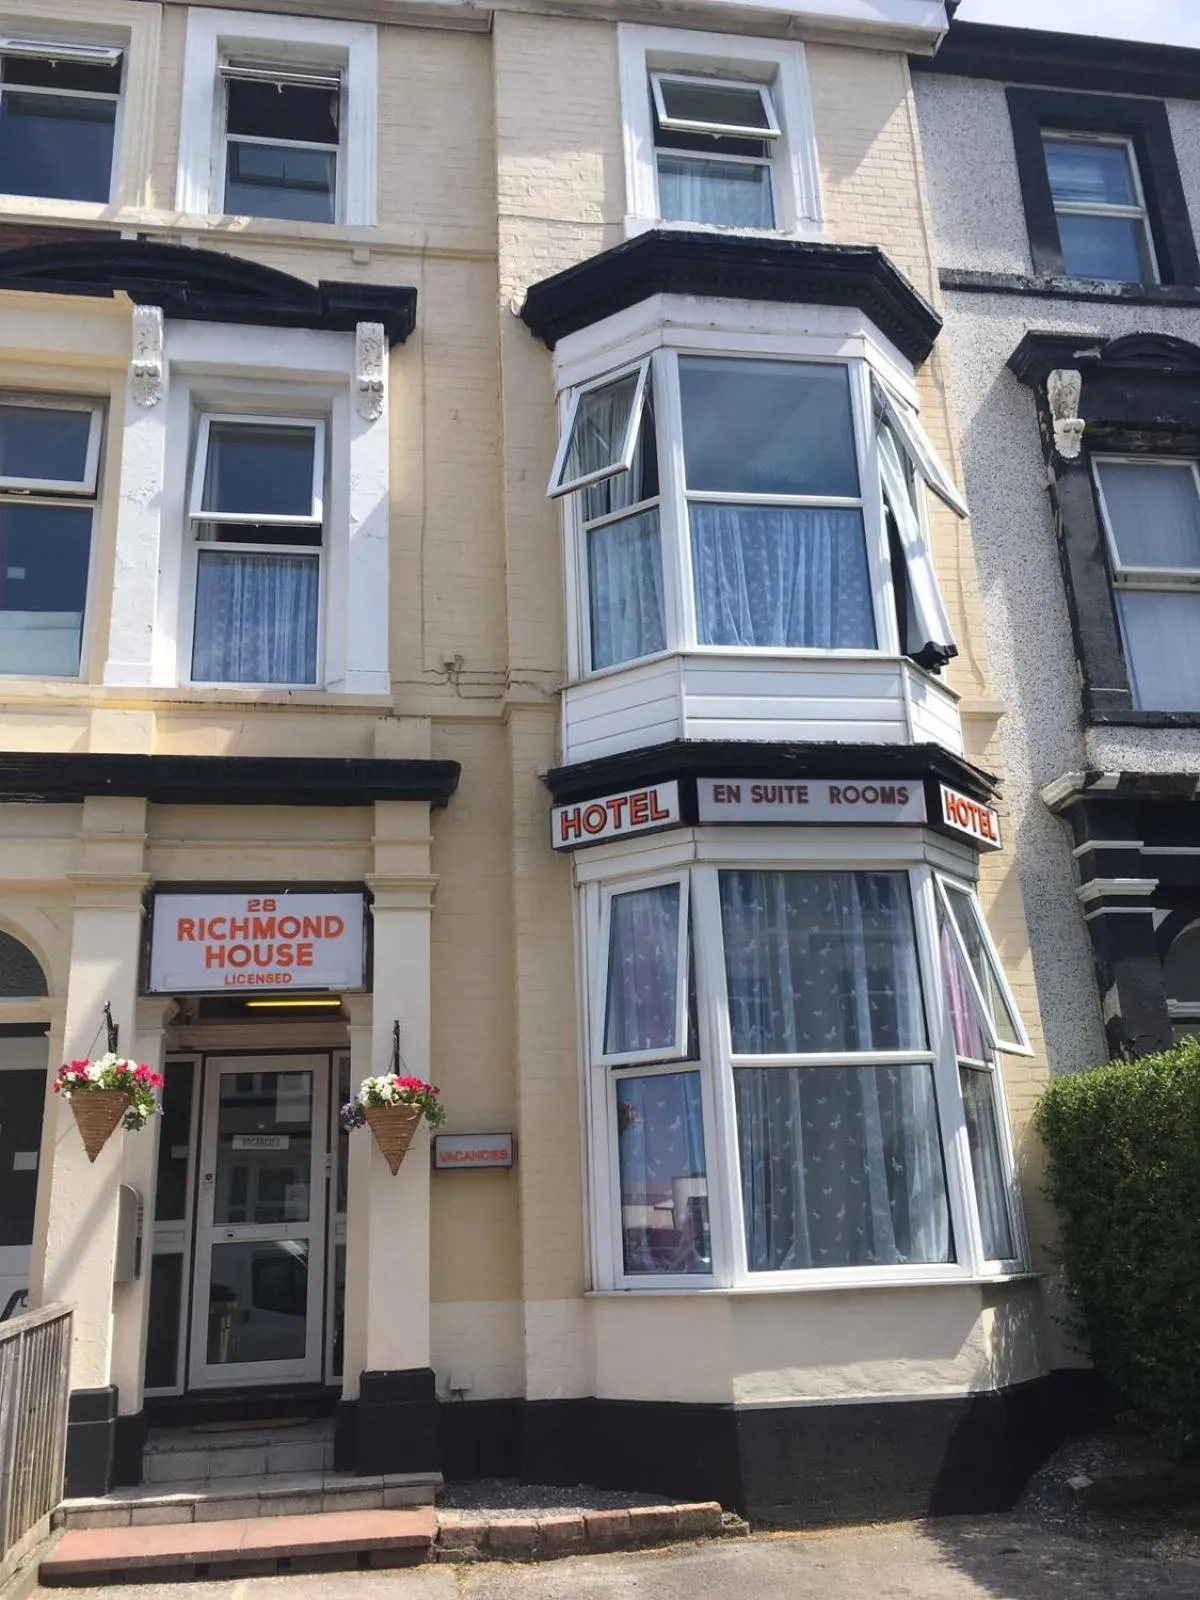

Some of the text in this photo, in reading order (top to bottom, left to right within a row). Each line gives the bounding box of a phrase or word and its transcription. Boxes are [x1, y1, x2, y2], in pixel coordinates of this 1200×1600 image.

[713, 784, 909, 805] EN SUITE ROOMS
[560, 789, 670, 841] HOTEL
[944, 789, 997, 841] HOTEL
[247, 899, 276, 912] 28
[177, 915, 344, 941] RICHMOND
[204, 943, 313, 968] HOUSE
[224, 973, 292, 985] LICENSED
[440, 1149, 508, 1162] VACANCIES
